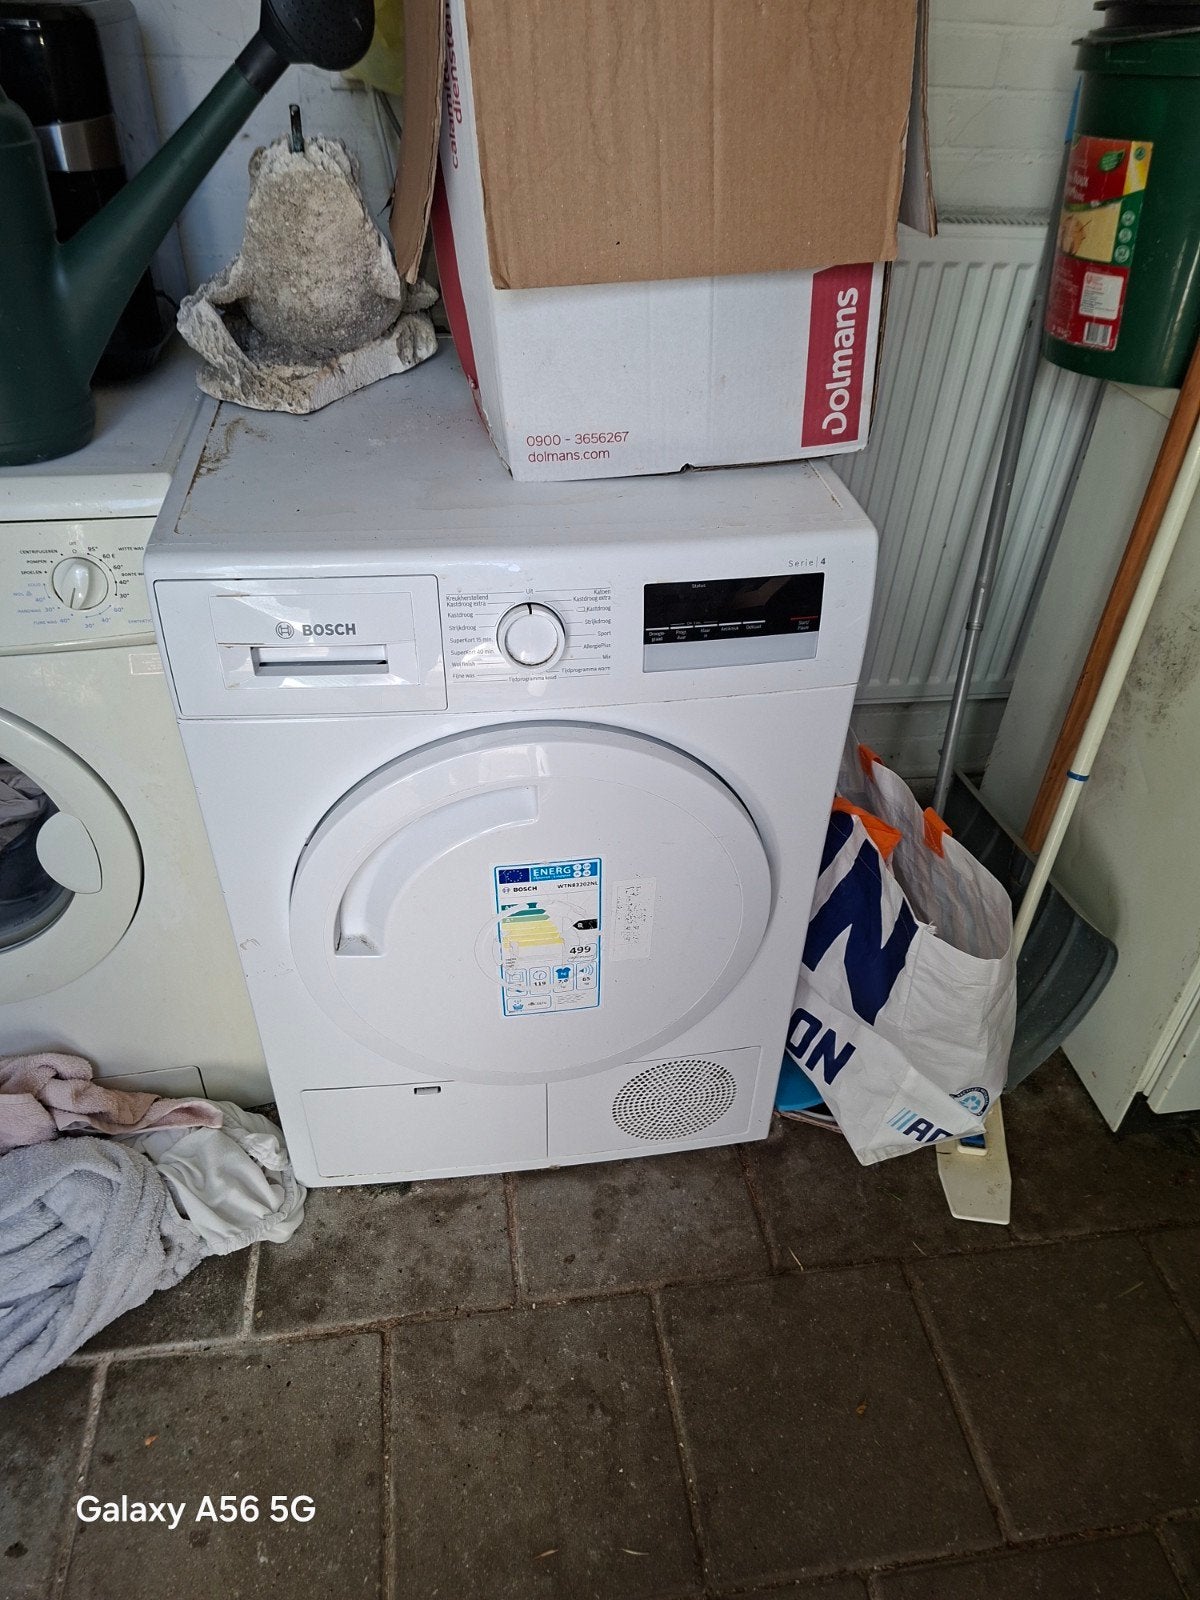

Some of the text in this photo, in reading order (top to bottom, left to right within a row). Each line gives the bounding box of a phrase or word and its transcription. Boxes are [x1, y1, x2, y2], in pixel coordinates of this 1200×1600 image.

[822, 287, 858, 435] Dolmans
[526, 434, 561, 446] 0900
[575, 431, 629, 445] 3656267
[528, 449, 610, 462] dolmans.com
[788, 557, 826, 567] Serie 4
[302, 623, 356, 636] BOSCH
[533, 866, 571, 876] ENERG
[569, 946, 591, 954] 499
